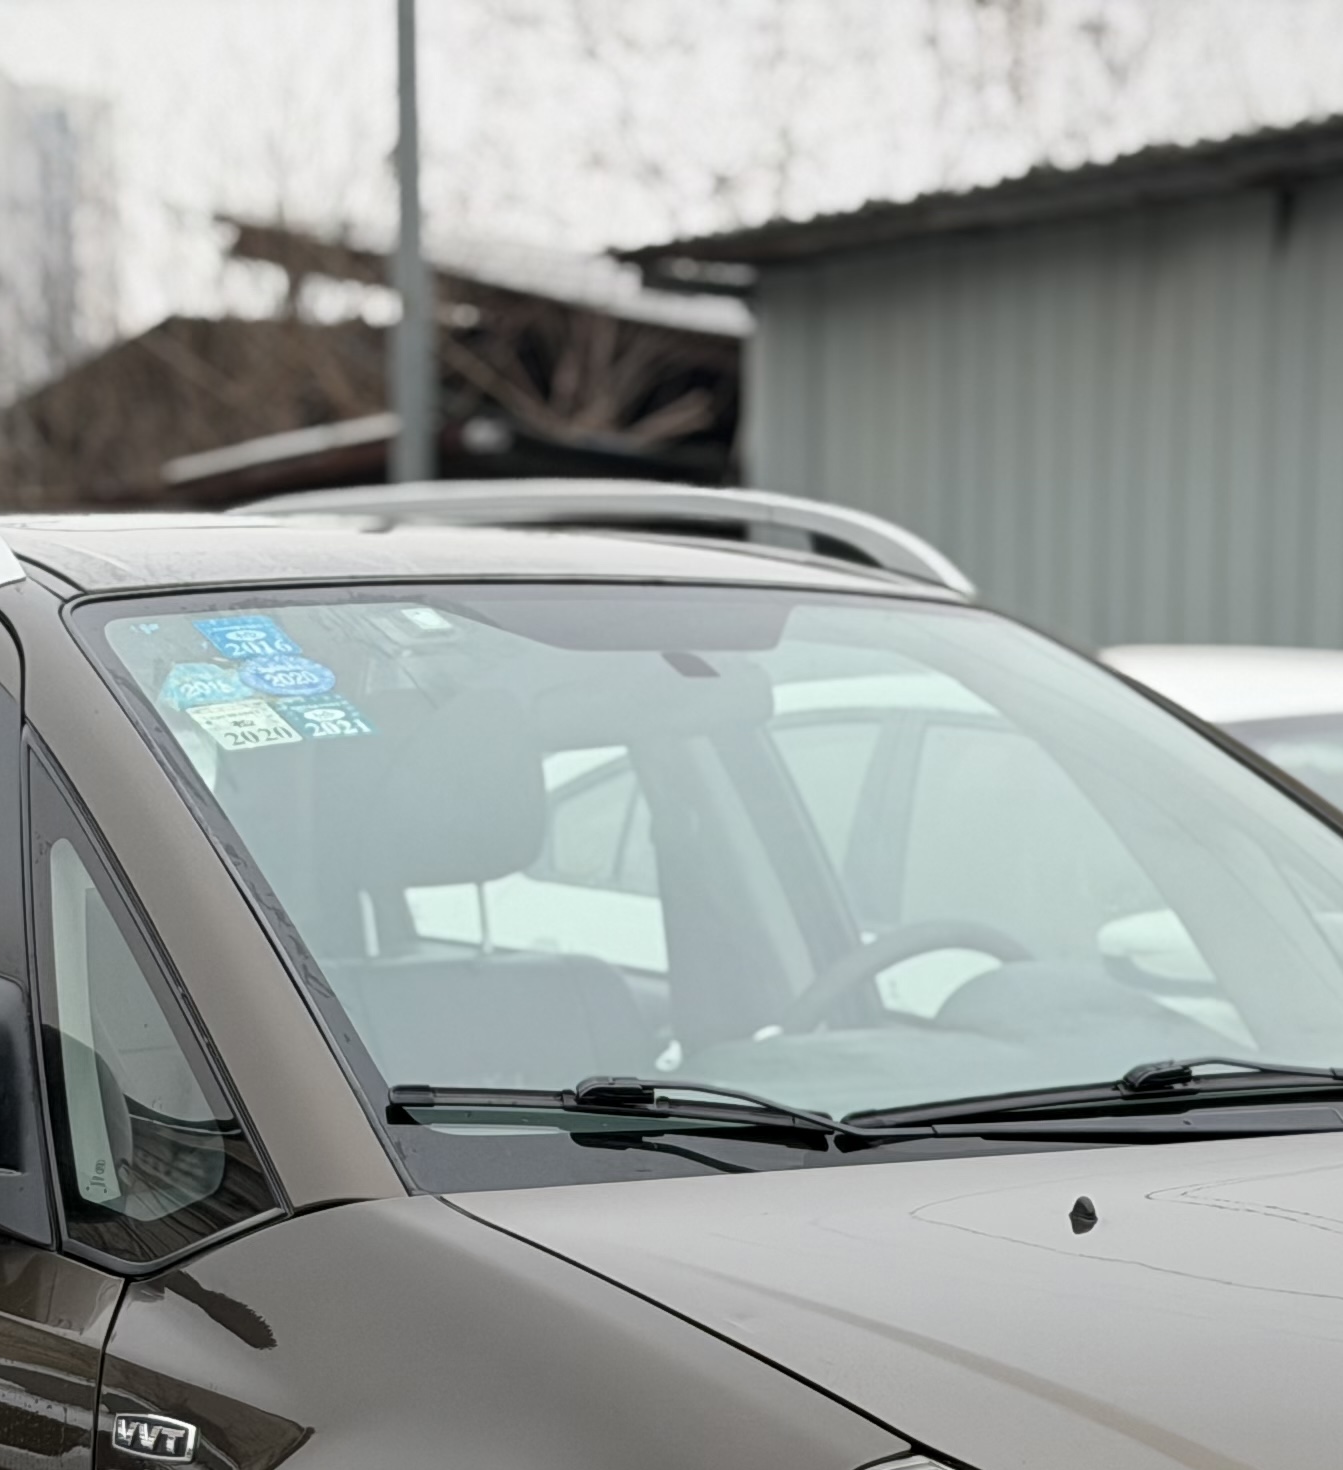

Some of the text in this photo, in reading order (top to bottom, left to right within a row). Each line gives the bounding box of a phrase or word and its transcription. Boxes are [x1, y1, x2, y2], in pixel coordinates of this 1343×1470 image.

[223, 638, 293, 656] 2016
[263, 670, 320, 688] 2020
[223, 725, 293, 747] 2020
[304, 718, 372, 737] 2021
[116, 1418, 186, 1455] VVT
